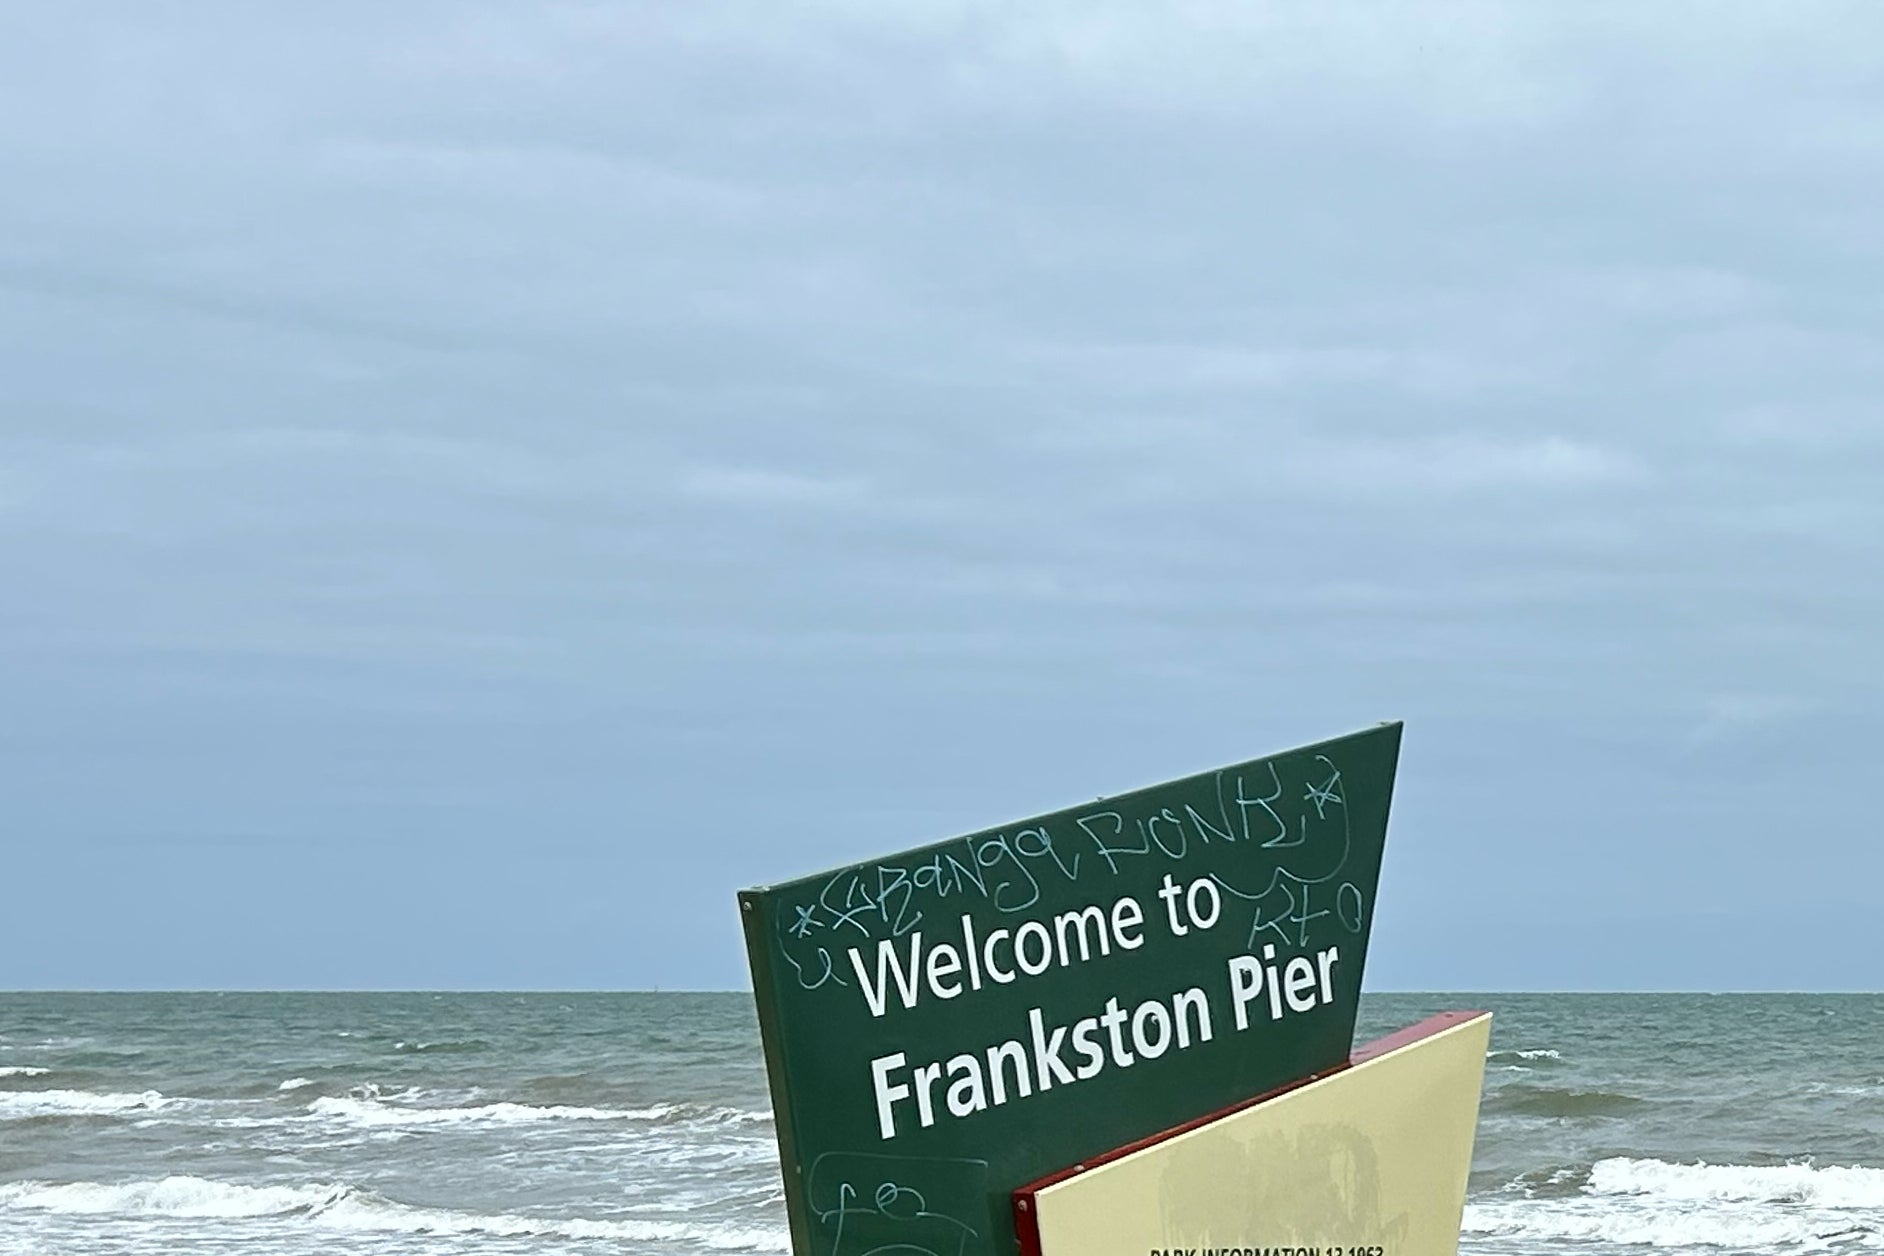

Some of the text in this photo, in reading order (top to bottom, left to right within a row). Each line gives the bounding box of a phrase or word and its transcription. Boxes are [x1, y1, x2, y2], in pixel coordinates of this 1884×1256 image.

[848, 873, 1222, 1017] Welcome to
[870, 943, 1339, 1140] Frankston Pier
